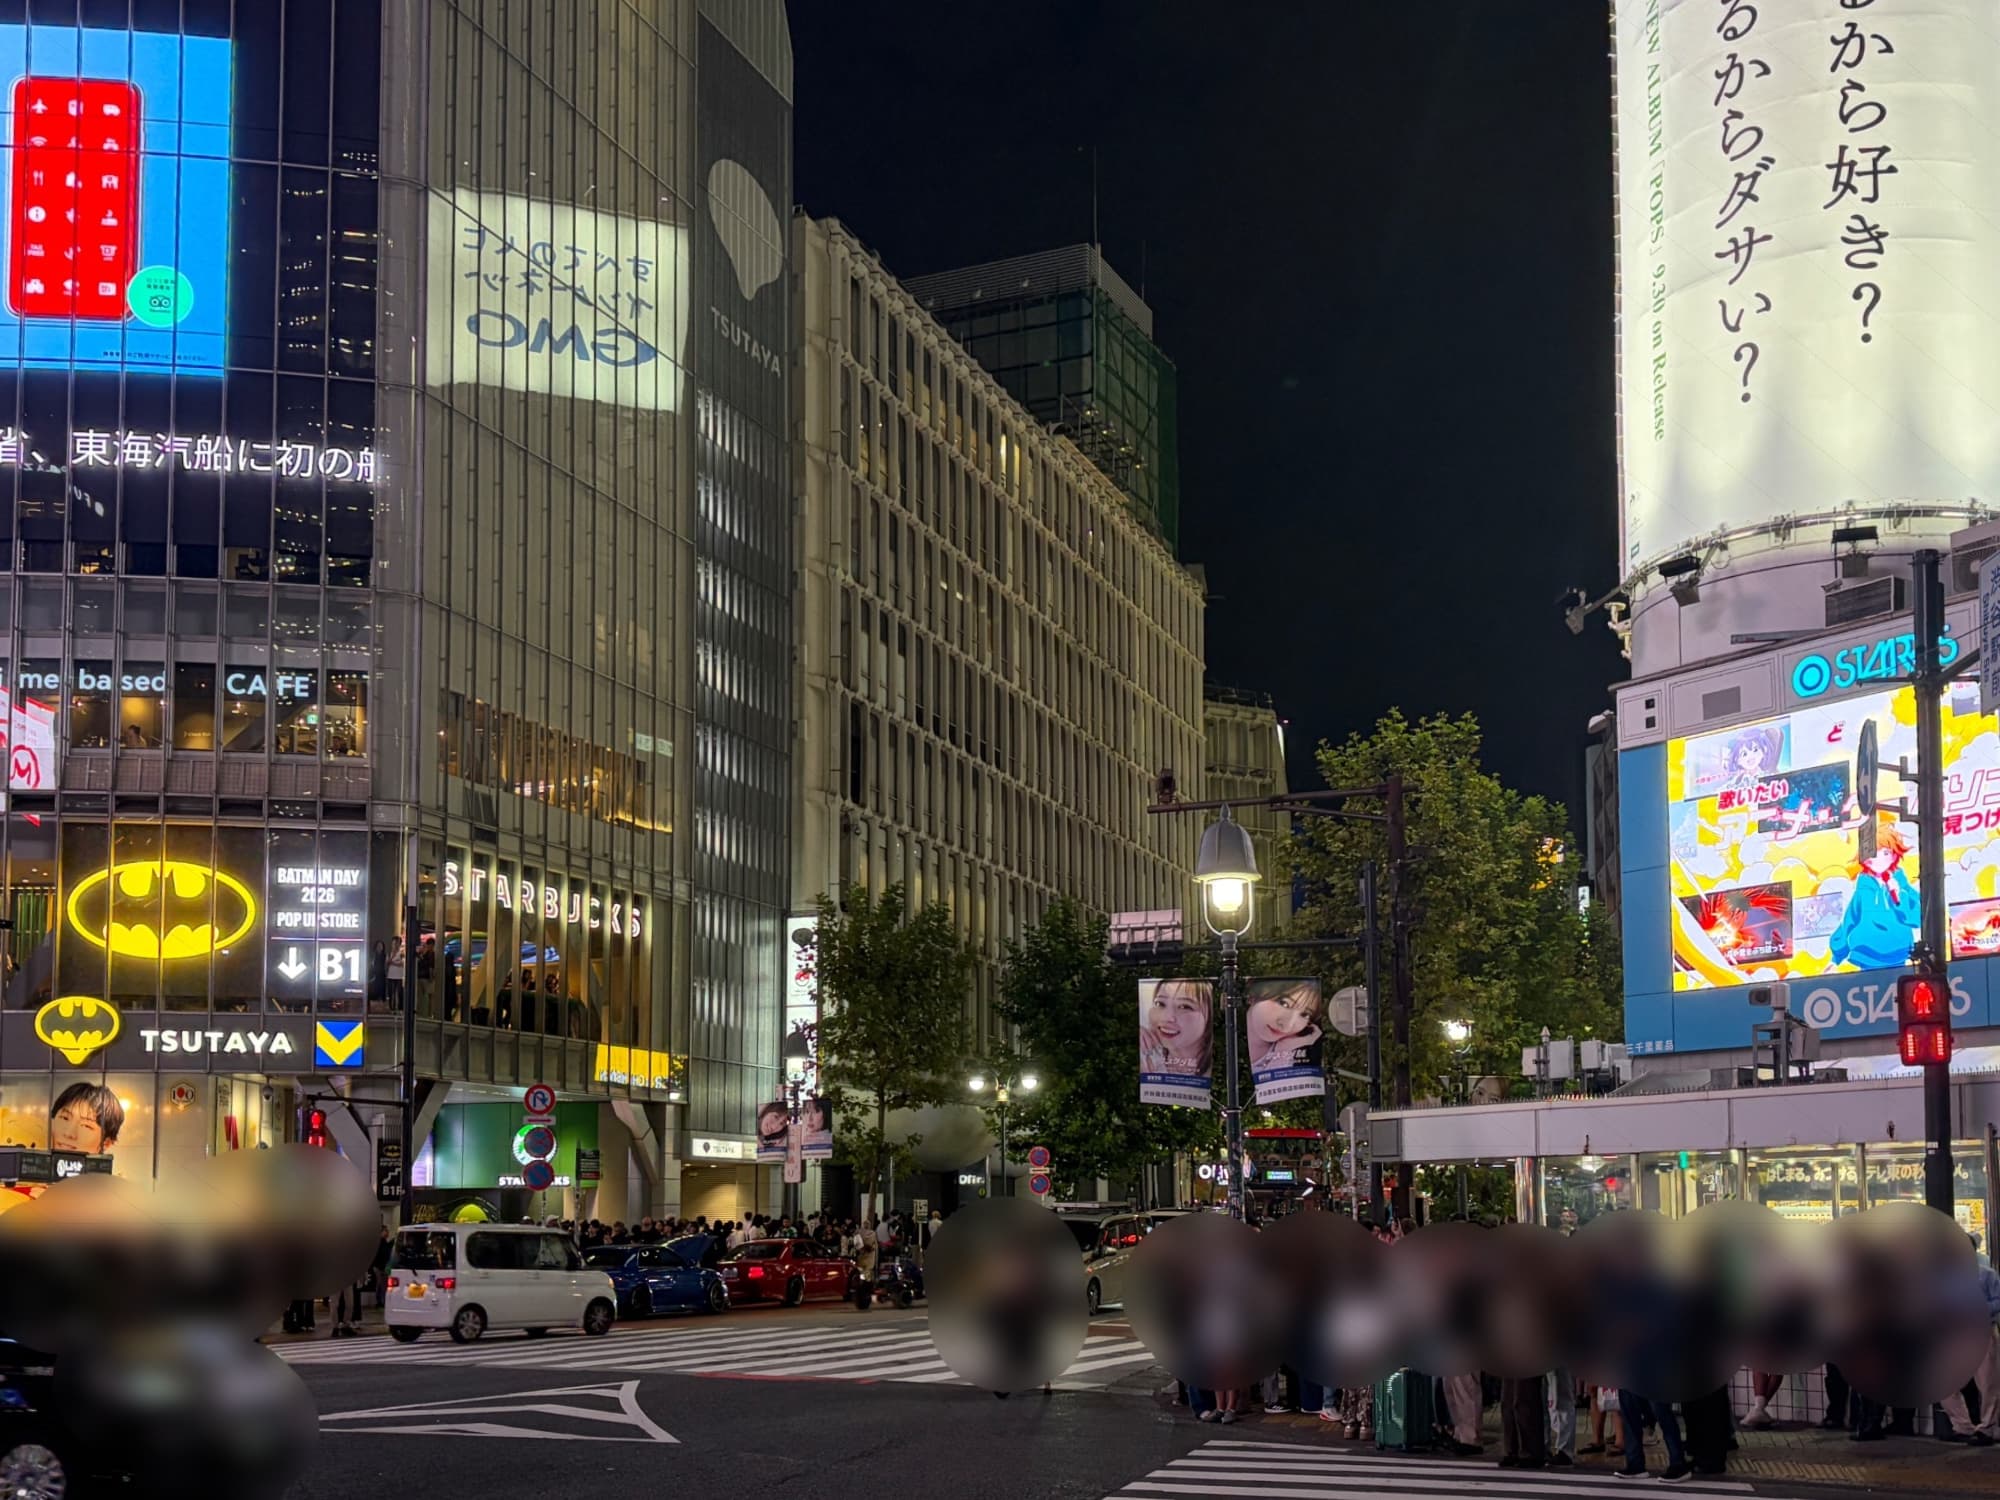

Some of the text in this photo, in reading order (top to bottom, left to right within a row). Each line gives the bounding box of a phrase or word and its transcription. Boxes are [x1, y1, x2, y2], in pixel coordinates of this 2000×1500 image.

[1647, 63, 1665, 157] ALBUM
[1822, 0, 1898, 344] から好き？
[1651, 263, 1666, 314] 9.30
[711, 306, 783, 378] TSUTAYA
[1651, 321, 1665, 350] on
[1651, 351, 1667, 442] Release
[79, 668, 166, 692] based
[226, 672, 309, 698] CAFE
[1826, 720, 1845, 744] ど
[1718, 780, 1790, 810] 歌いたい
[277, 867, 360, 886] BATMAN DAY
[301, 886, 335, 903] 2026
[277, 911, 301, 928] POP
[320, 912, 360, 928] STORE
[319, 947, 361, 982] B1
[1845, 976, 1972, 1025] STAS
[140, 1029, 293, 1054] TSUTAYA
